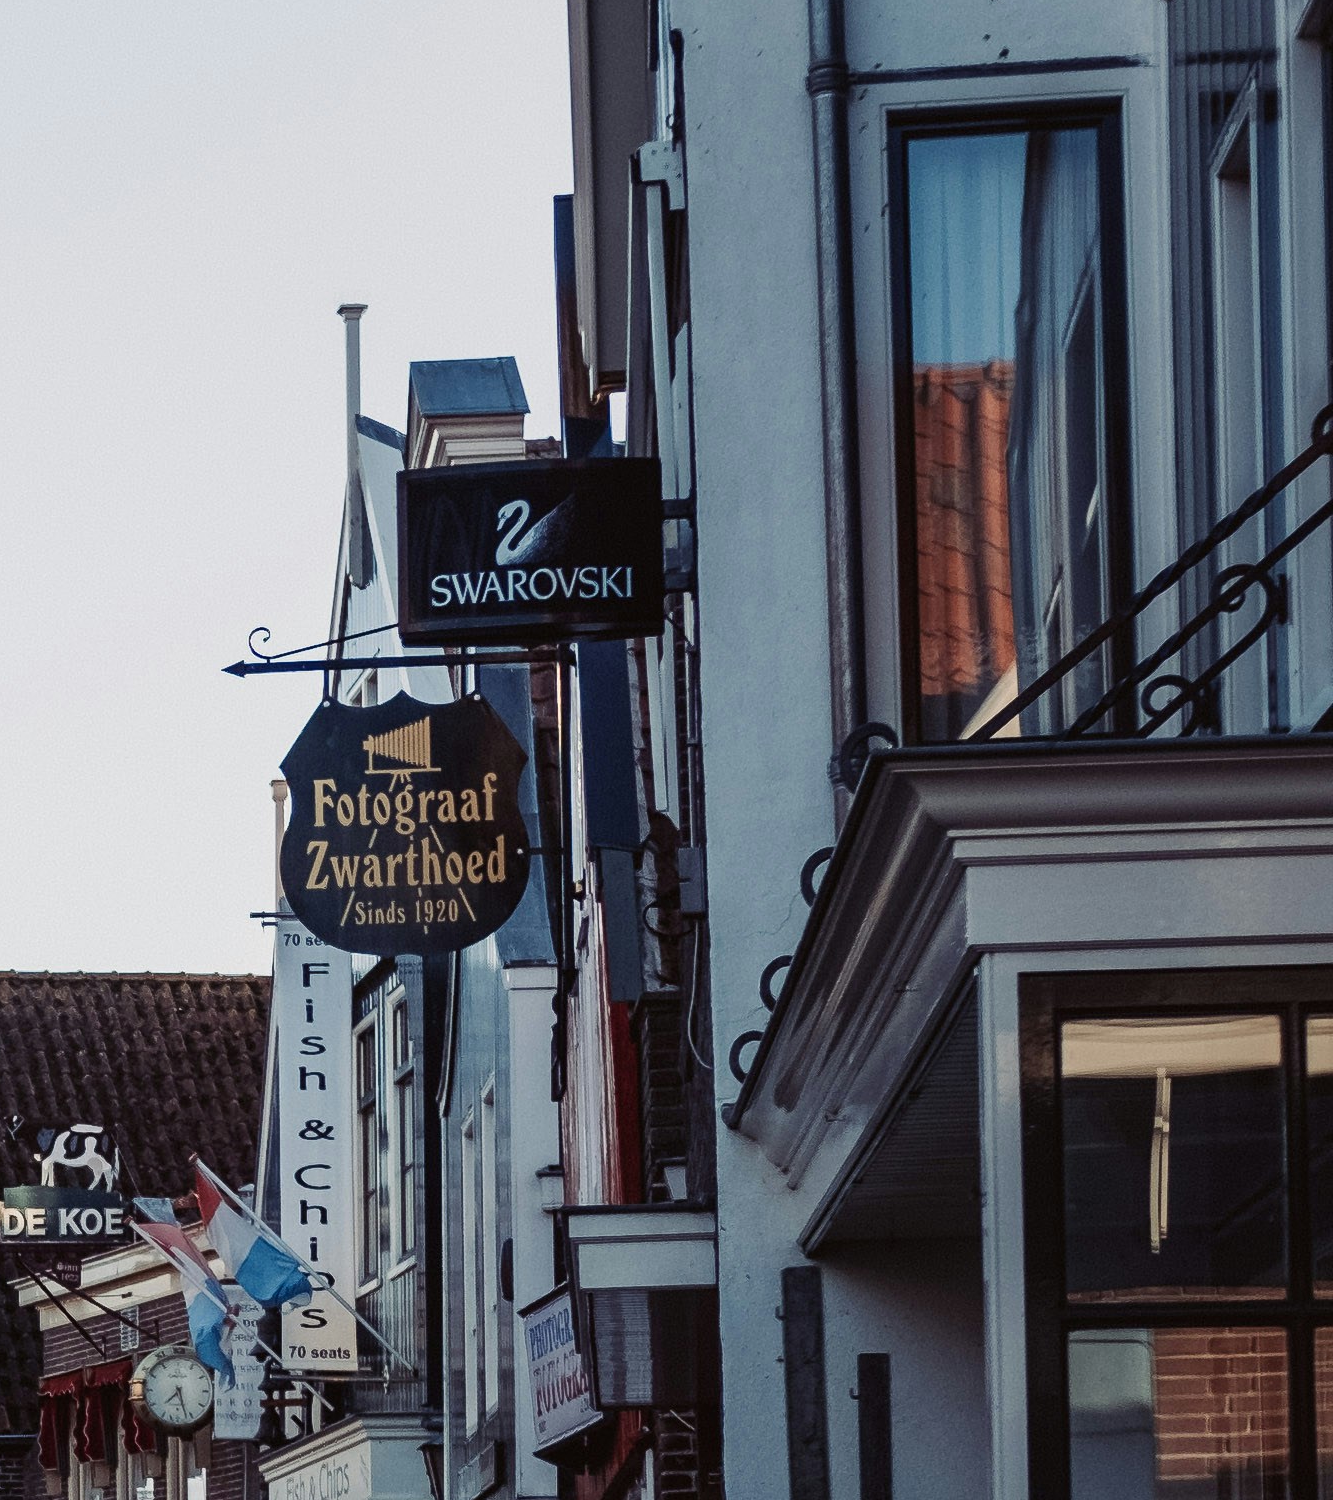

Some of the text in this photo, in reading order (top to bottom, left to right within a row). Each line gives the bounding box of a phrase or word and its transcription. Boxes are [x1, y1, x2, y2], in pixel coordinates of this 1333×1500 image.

[431, 566, 633, 607] SWAROVSKI
[313, 772, 498, 835] Fotograaf
[305, 834, 507, 890] Zwarthoed
[354, 899, 459, 925] Sinds 1920
[283, 933, 328, 947] 70 se
[298, 962, 331, 1091] Fish
[298, 1119, 335, 1141] &
[2, 1207, 124, 1236] DE KOE
[288, 1345, 352, 1360] 70 seats
